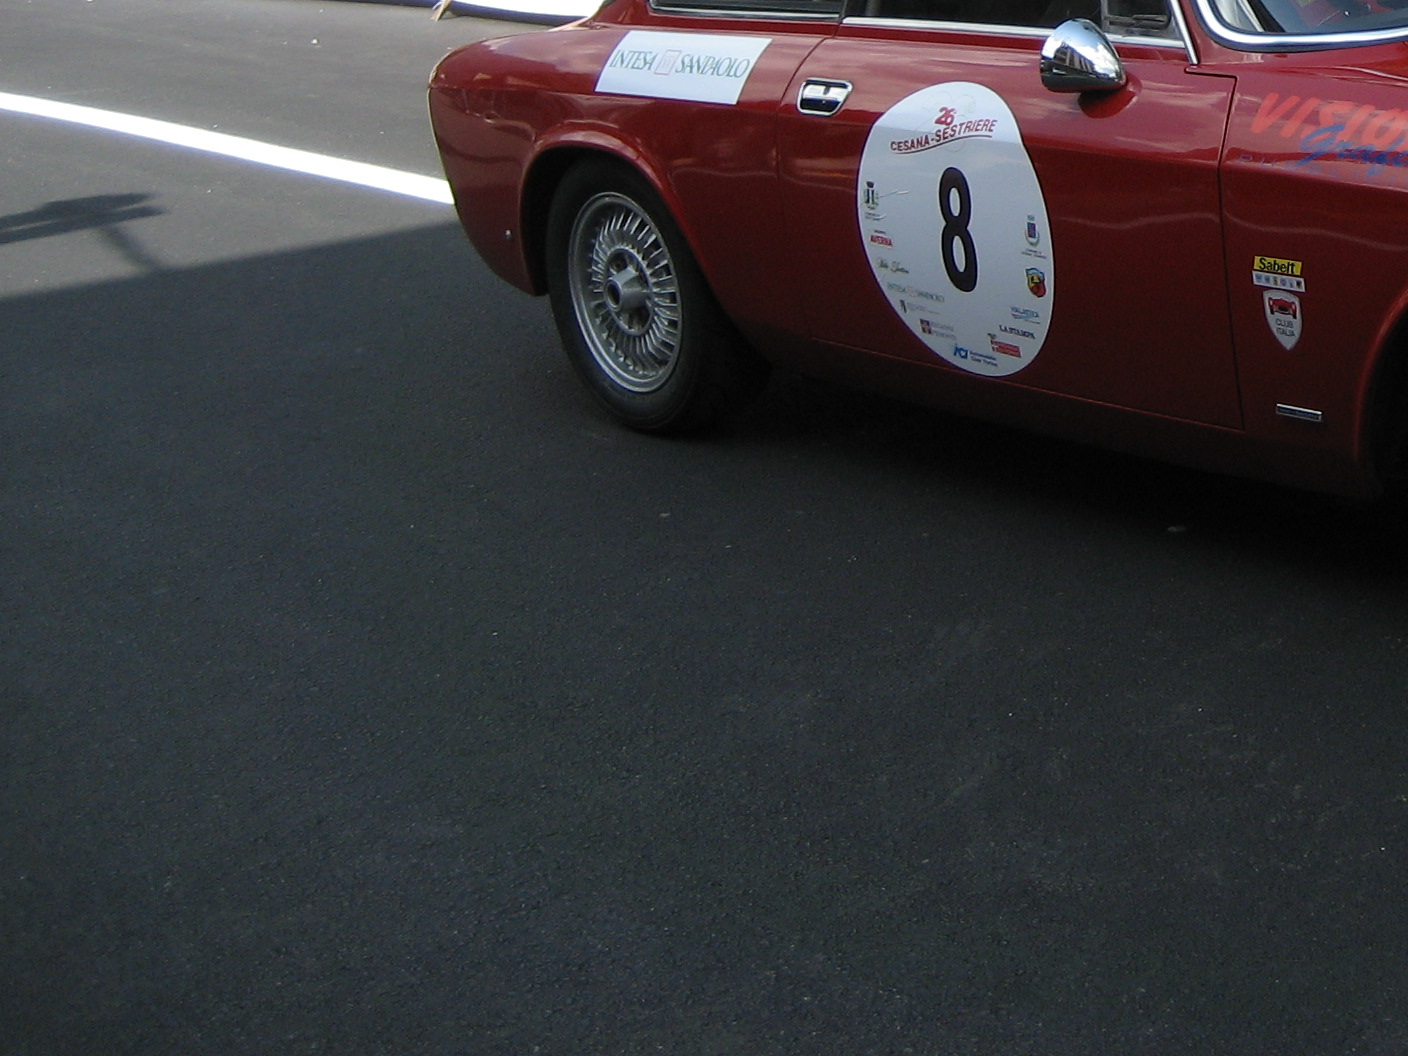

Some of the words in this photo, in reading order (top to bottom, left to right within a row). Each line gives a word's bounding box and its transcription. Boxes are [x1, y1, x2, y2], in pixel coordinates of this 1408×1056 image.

[609, 49, 657, 71] INTESA
[675, 53, 751, 79] SANPAOLO
[890, 119, 998, 152] CESANA-SESTRIERE
[939, 166, 978, 292] 8
[1259, 257, 1295, 274] Sabelt
